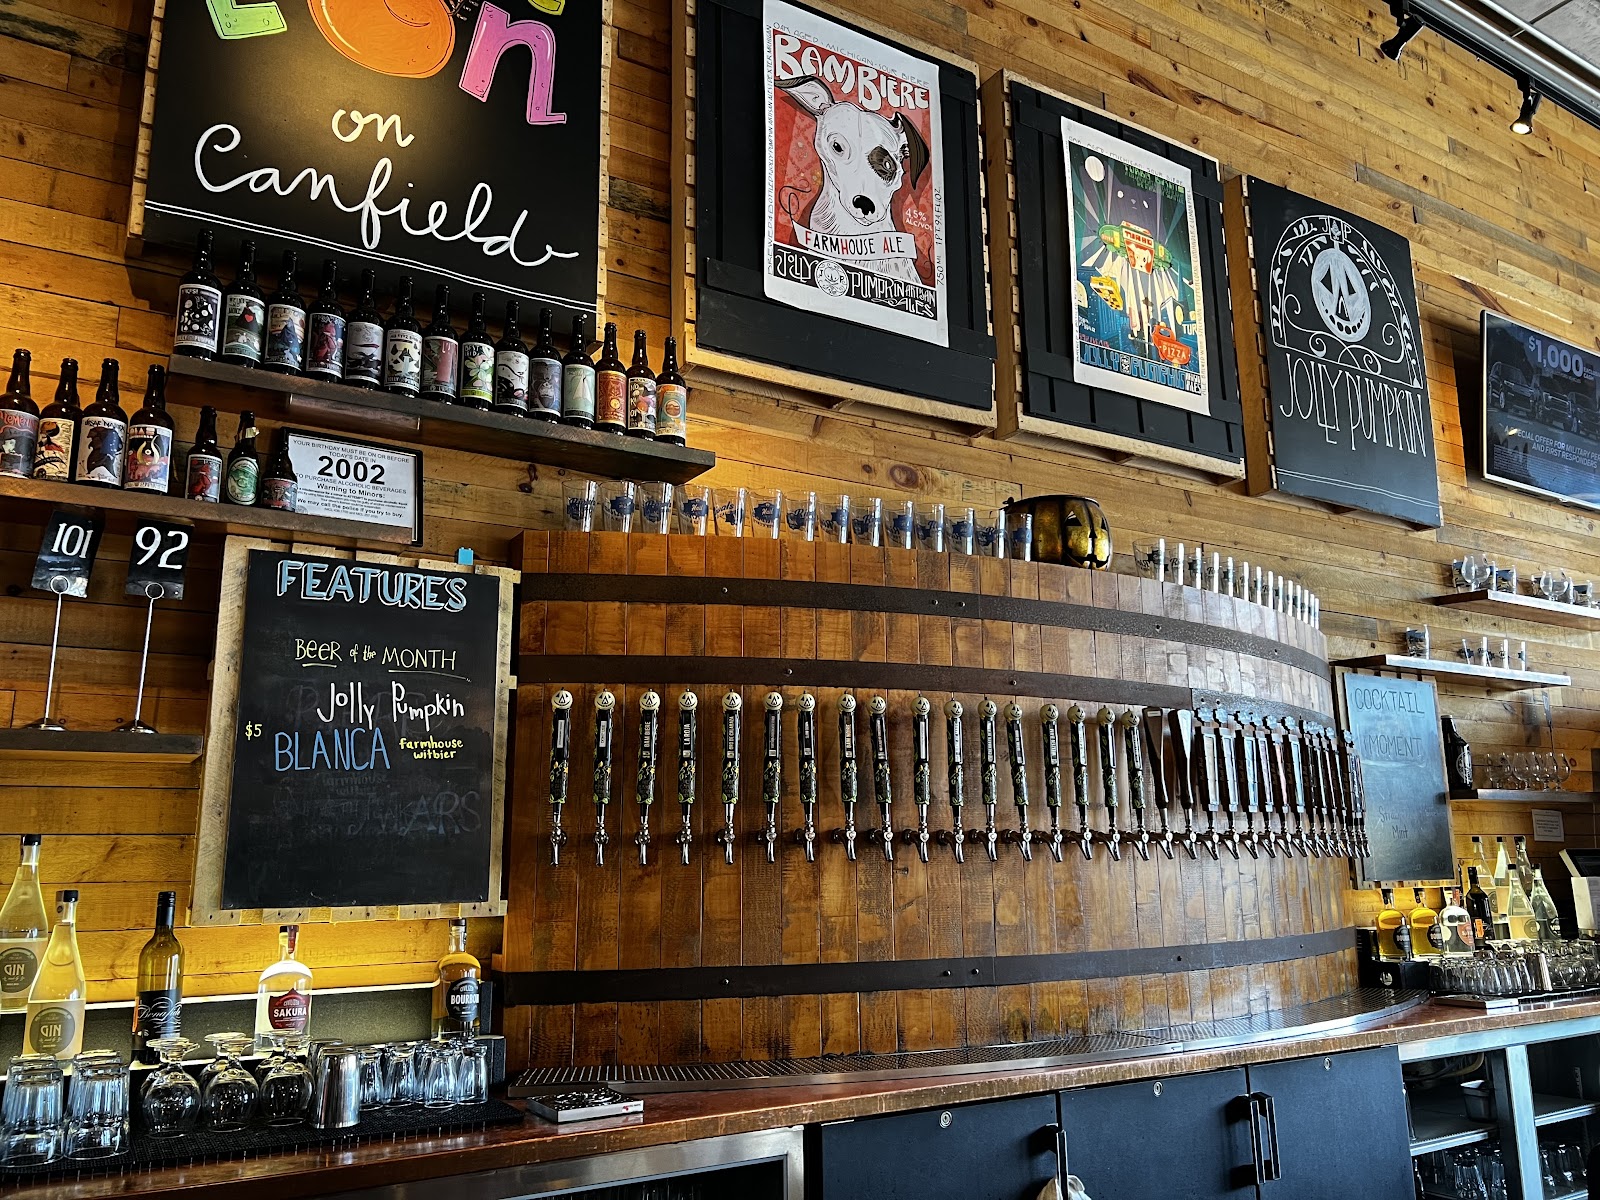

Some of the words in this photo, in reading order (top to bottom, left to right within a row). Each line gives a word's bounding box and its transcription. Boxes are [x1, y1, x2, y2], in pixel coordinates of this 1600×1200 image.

[331, 109, 416, 148] on
[195, 123, 580, 268] Canfield
[905, 207, 928, 222] 4.5%
[1319, 217, 1330, 234] J
[1343, 223, 1352, 238] P
[805, 231, 876, 256] FARMHOUSE
[883, 237, 906, 254] ALE
[775, 249, 818, 282] JOLLY
[848, 270, 904, 298] PUMPKIN
[1162, 345, 1186, 360] PIZZA
[1528, 335, 1584, 378] $1,000
[1280, 353, 1342, 446] JOLLY
[1345, 371, 1427, 457] PUMPKIN
[293, 439, 310, 448] YOUR
[312, 442, 340, 452] BIRTHDAY
[387, 455, 410, 464] BEFORE
[328, 451, 354, 460] TODAY'S
[354, 456, 370, 464] DATE
[1532, 443, 1546, 452] AND
[1545, 447, 1562, 458] FIRST
[1562, 452, 1598, 470] RESPONDERS
[1535, 434, 1554, 448] OFFER
[1554, 441, 1566, 450] FOR
[1566, 444, 1592, 458] MILITARY
[318, 455, 386, 486] 2002
[305, 474, 338, 484] PURCHASE
[338, 479, 370, 490] ALCOHOLIC
[372, 485, 406, 494] BEVERAGES
[316, 482, 348, 494] Warning
[358, 489, 386, 500] Minors:
[51, 522, 94, 558] 101
[135, 526, 188, 570] 92
[277, 559, 468, 612] FEATURES
[349, 644, 360, 662] of
[362, 645, 376, 662] the
[381, 647, 458, 670] MONTH
[317, 681, 374, 730] Jolly
[392, 680, 464, 732] Pumpkin
[1354, 687, 1424, 714] COCKTAIL
[245, 721, 262, 742] $5
[399, 735, 464, 750] farmhouse
[275, 727, 390, 772] BLANCA
[413, 749, 458, 760] witbier
[1368, 734, 1422, 756] MOMENT
[4, 963, 24, 976] GIN
[273, 1006, 306, 1018] SAKURA
[40, 1024, 62, 1036] GIN
